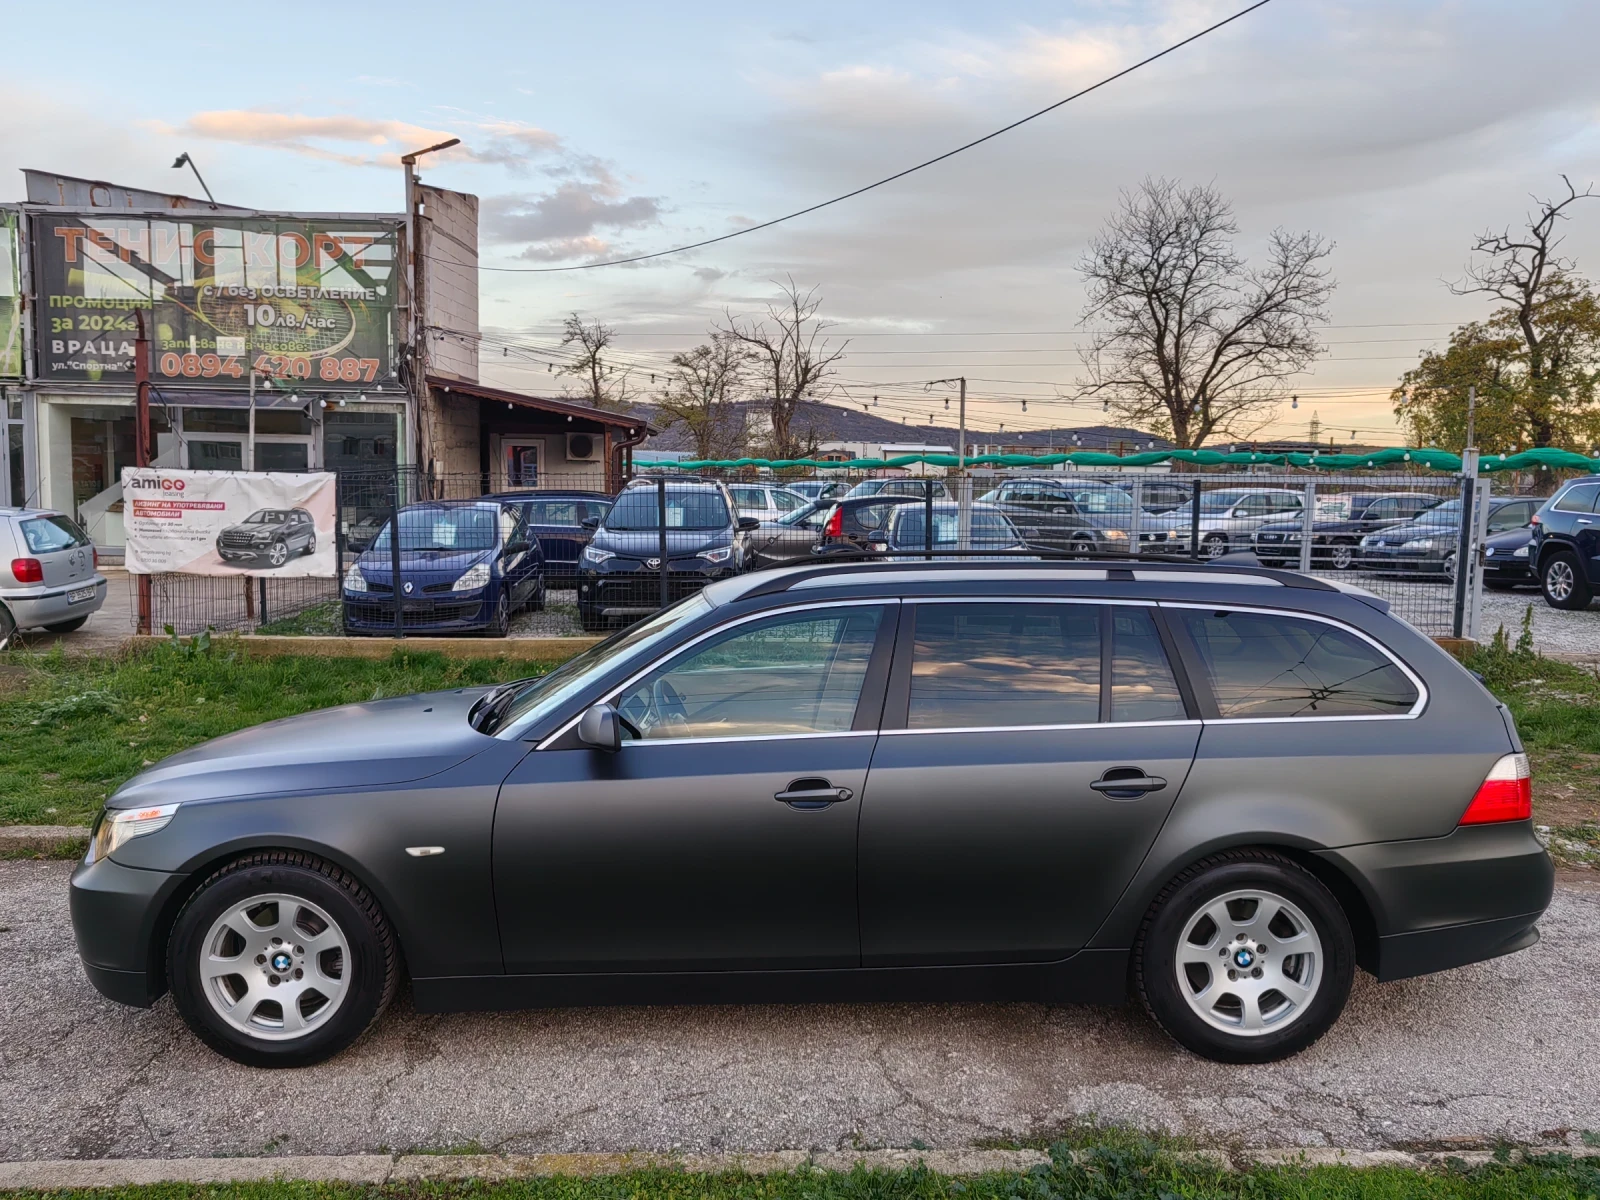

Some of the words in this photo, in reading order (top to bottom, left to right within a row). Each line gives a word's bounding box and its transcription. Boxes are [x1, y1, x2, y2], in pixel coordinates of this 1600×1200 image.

[54, 227, 226, 266] ТЕНИС
[243, 231, 374, 270] КОРТ
[228, 284, 257, 300] без
[261, 284, 376, 301] ОСВЕТЛЕНИЕ
[49, 295, 153, 311] ПРОМОЦИЯ
[51, 317, 74, 333] за
[51, 339, 133, 357] ВРАЦА
[162, 337, 233, 350] записване
[160, 352, 244, 378] 0894
[253, 354, 312, 380] 420
[320, 357, 380, 382] 887
[163, 490, 185, 499] leasing
